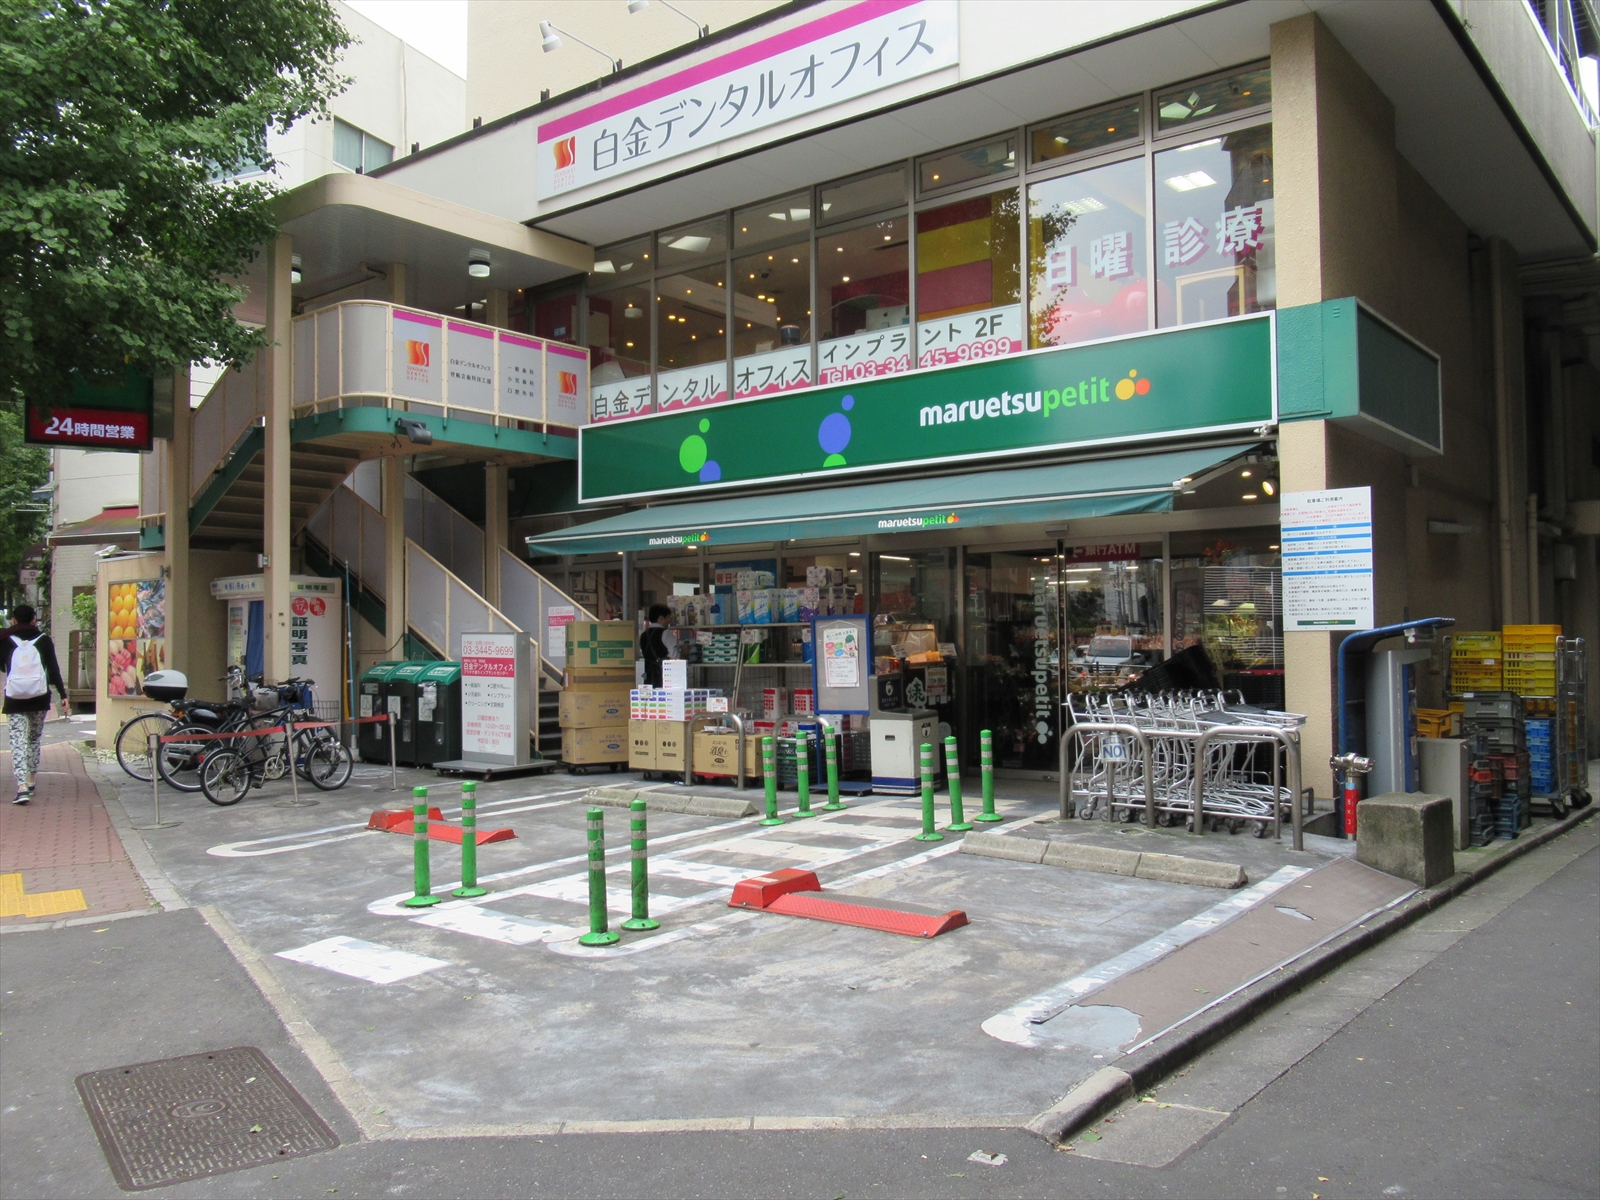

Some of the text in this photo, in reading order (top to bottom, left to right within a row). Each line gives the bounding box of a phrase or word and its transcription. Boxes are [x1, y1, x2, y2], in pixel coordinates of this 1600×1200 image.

[593, 18, 935, 172] 白金デンタルオフィス
[974, 313, 1004, 339] 2F
[406, 371, 429, 379] DENTAL
[406, 376, 429, 384] OFFICE
[44, 416, 135, 439] 24時間営業
[291, 616, 308, 665] 証明写真
[463, 645, 514, 656] 03-3445-9699
[463, 662, 514, 672] 白金デンタルオフィス
